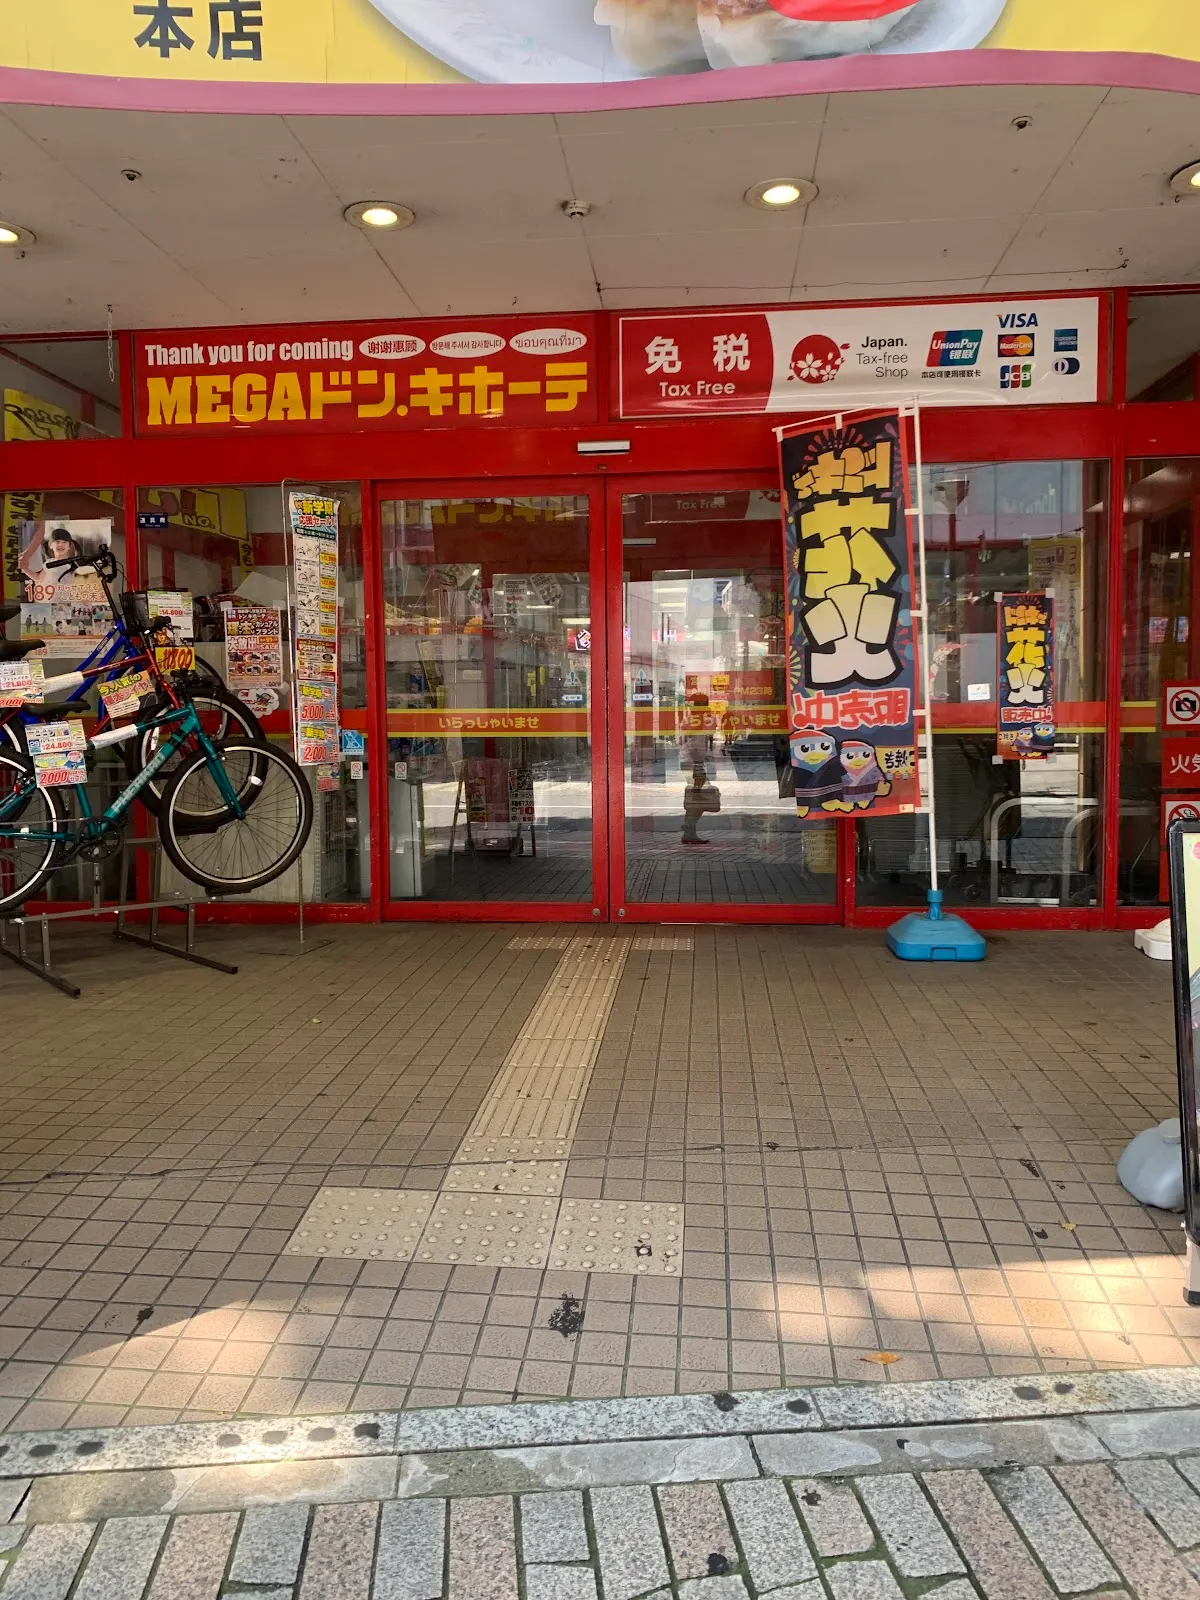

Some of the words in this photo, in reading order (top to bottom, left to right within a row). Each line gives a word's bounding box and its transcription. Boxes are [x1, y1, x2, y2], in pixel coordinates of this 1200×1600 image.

[133, 0, 263, 61] 本店
[996, 313, 1038, 328] VISA
[367, 339, 417, 354] 谢谢惠顾
[515, 332, 582, 349] ขอบคุณที่มา
[861, 337, 908, 350] Japan.
[931, 338, 979, 353] UnionPay
[145, 343, 205, 366] Thank
[208, 345, 243, 366] you
[247, 341, 275, 362] for
[279, 338, 353, 361] coming
[856, 352, 908, 365] Tax-free
[949, 349, 973, 360] 银联
[875, 366, 908, 379] Shop
[659, 382, 691, 397] Tax
[696, 380, 736, 396] Free
[25, 584, 55, 601] 189
[438, 716, 540, 729] いらっしゃいませ
